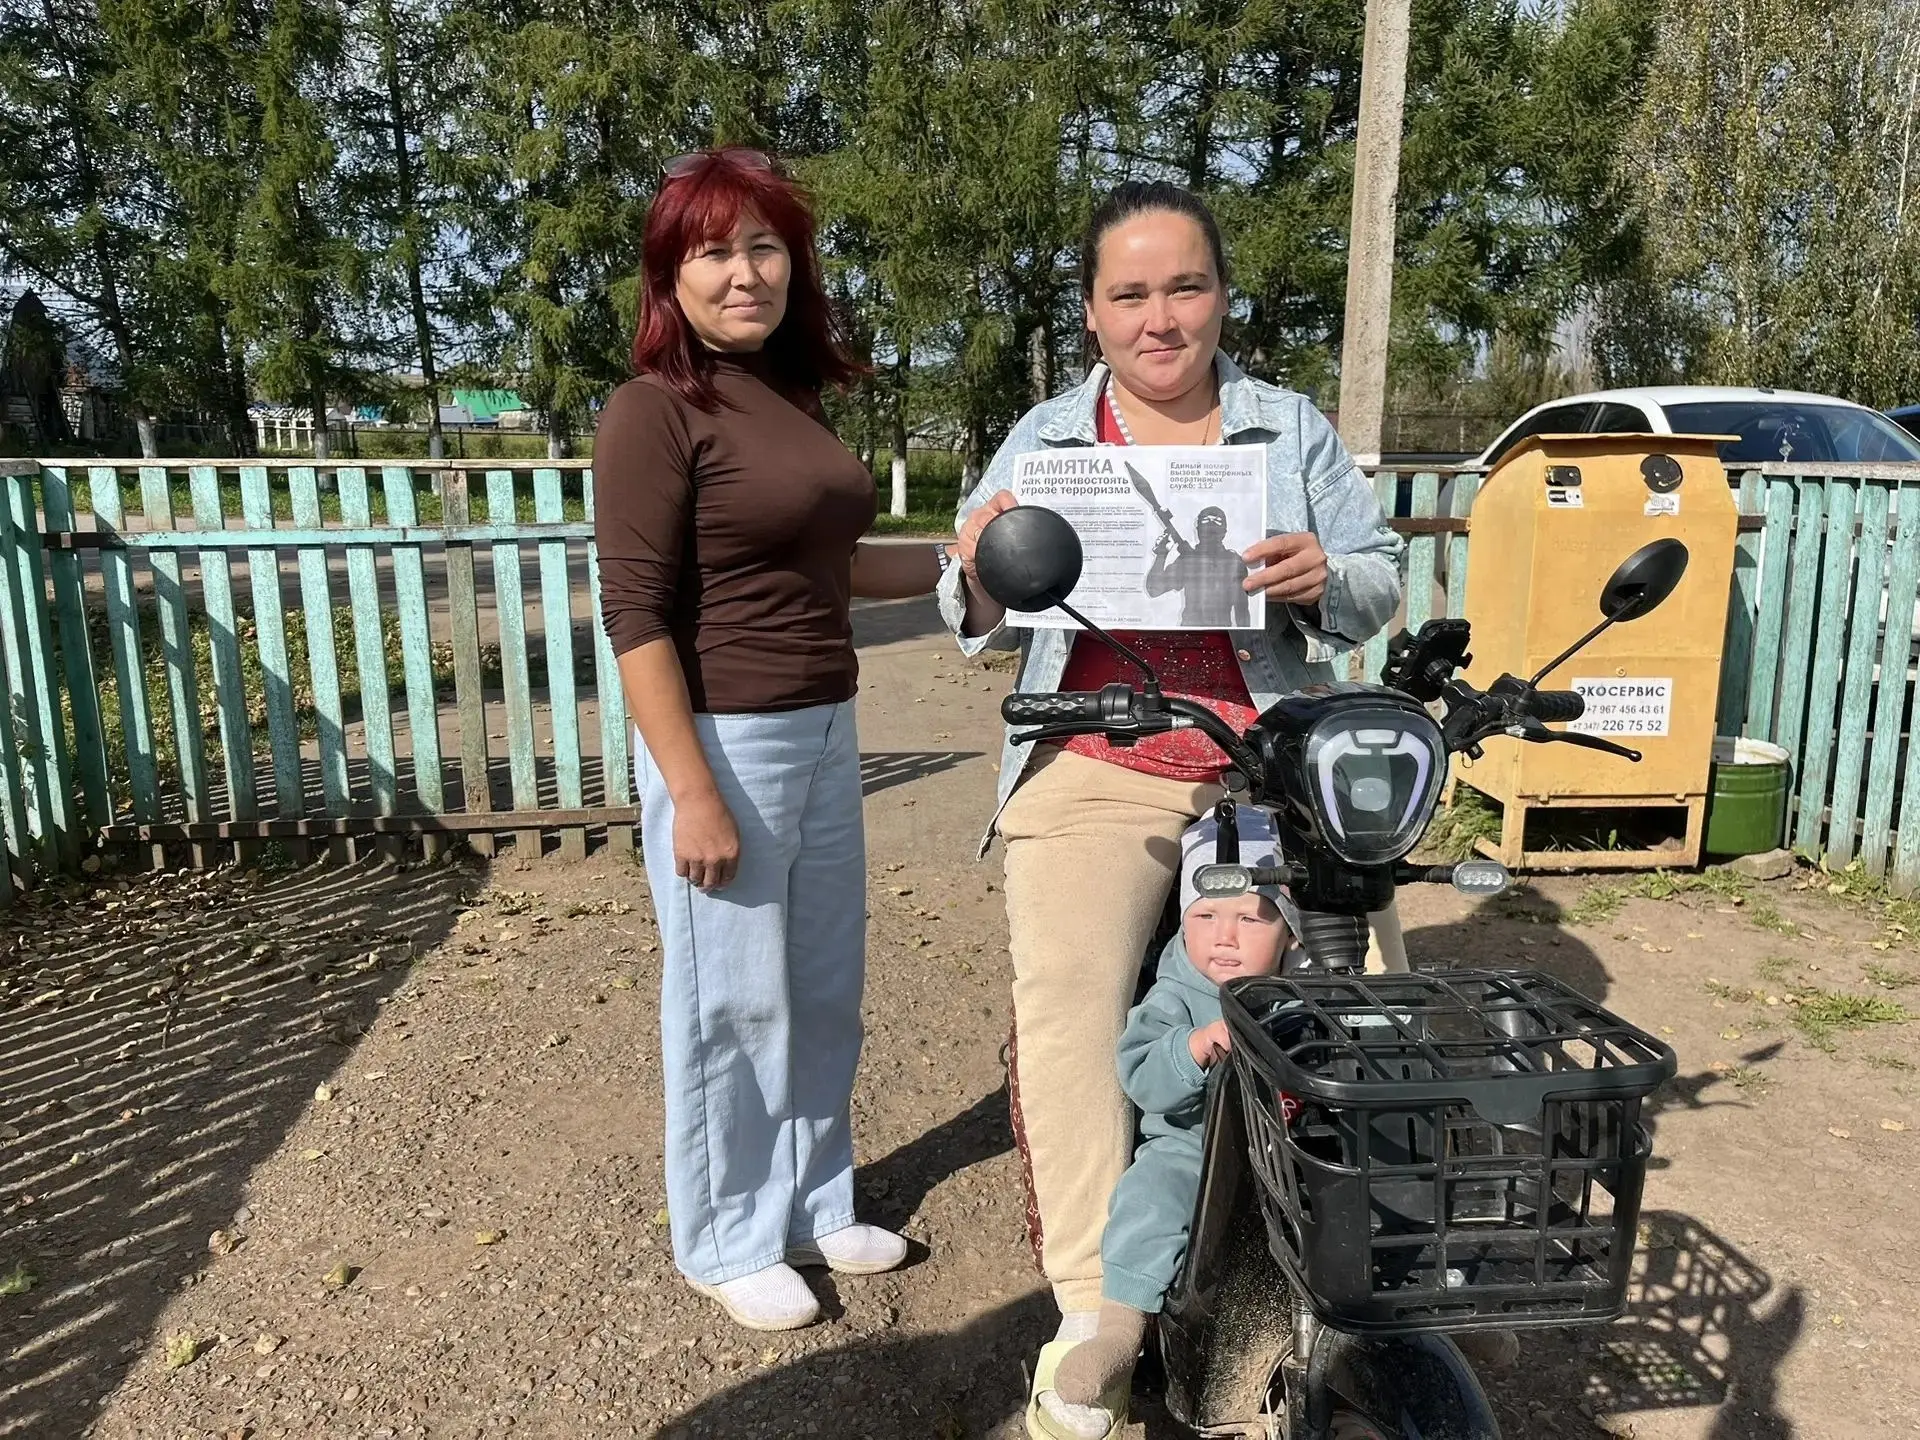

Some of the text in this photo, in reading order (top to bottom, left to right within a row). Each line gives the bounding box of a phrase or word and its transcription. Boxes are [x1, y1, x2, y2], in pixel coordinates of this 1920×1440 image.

[1023, 459, 1114, 476] ПАМЯТКА
[1170, 461, 1201, 469] Единый
[1204, 469, 1253, 477] экстренных
[1044, 476, 1129, 486] противостоять
[1020, 486, 1131, 496] угрозе терроризма
[1577, 685, 1666, 697] ЭКОСЕРВИС
[1587, 705, 1665, 714] +7 967 456 43 61
[1602, 720, 1624, 731] 226
[1628, 720, 1643, 731] 75
[1647, 720, 1662, 731] 52
